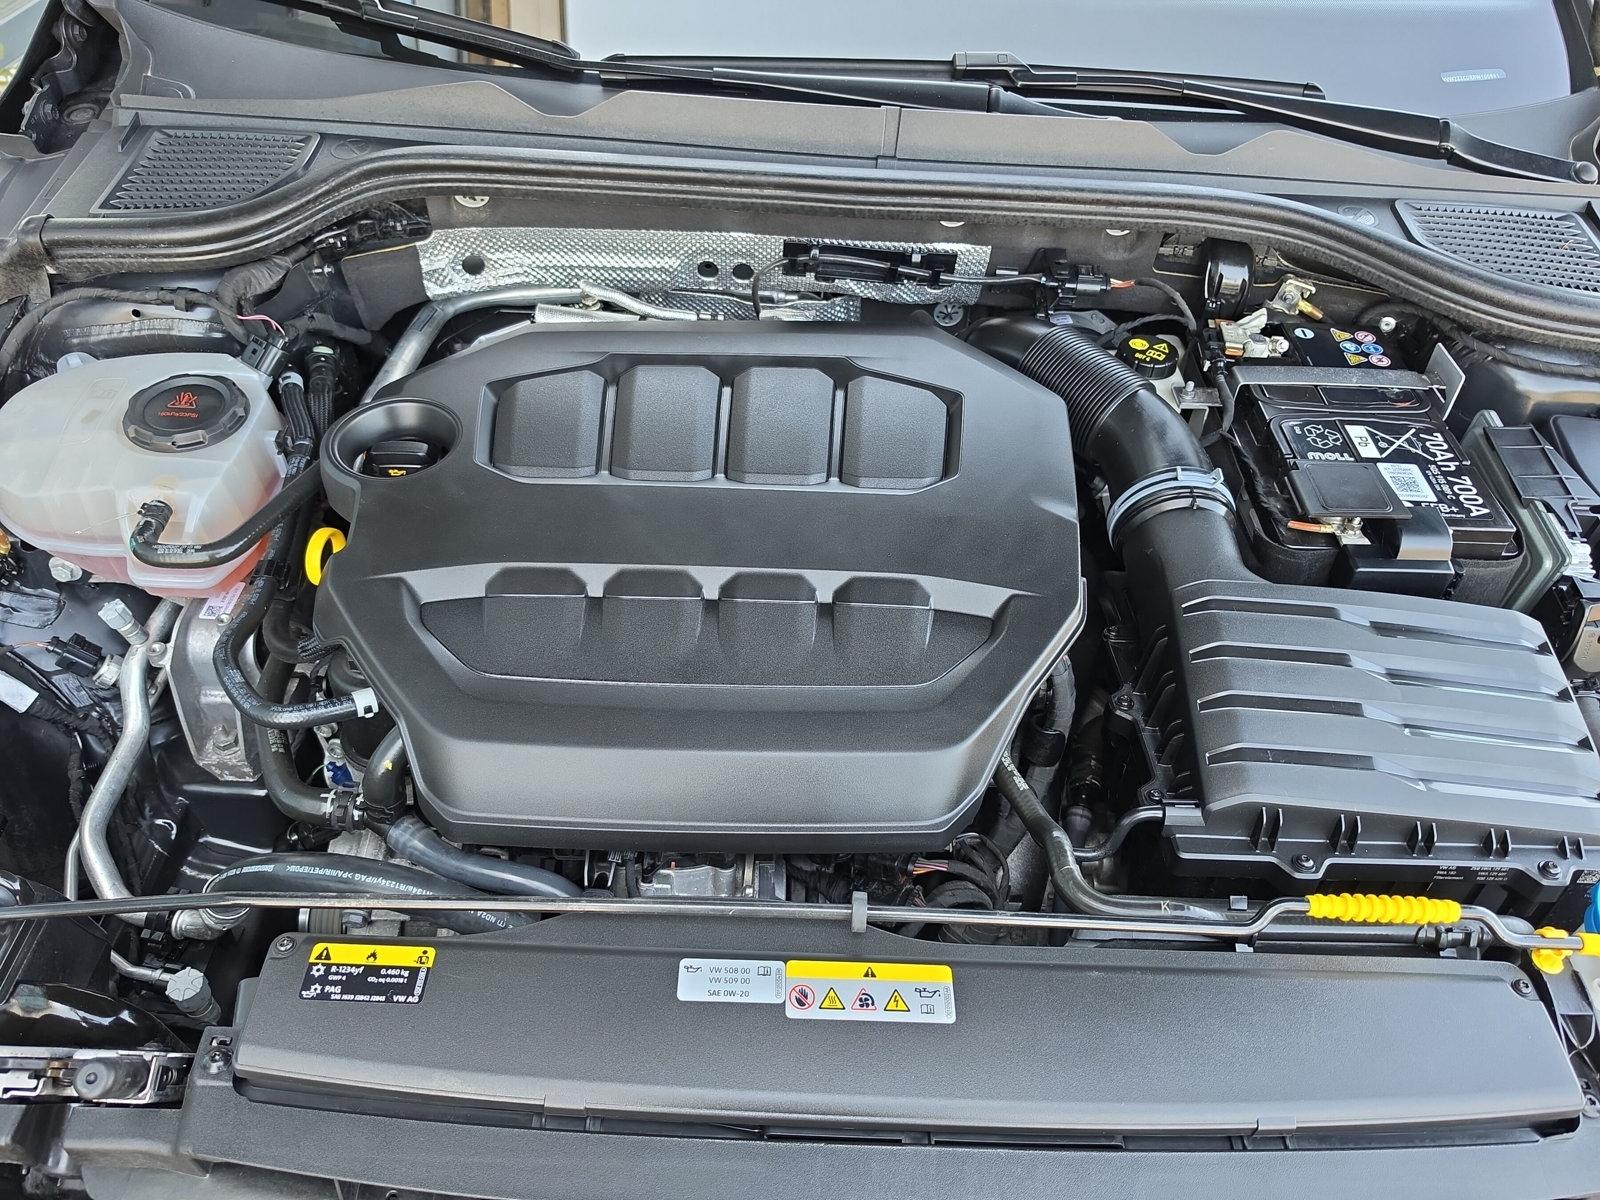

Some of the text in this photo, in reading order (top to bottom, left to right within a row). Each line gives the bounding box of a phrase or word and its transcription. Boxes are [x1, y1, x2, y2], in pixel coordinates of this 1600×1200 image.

[1355, 435, 1371, 448] Pb
[1419, 432, 1491, 517] 70Ah 700A
[330, 965, 364, 976] R-1234yf
[400, 969, 410, 977] kg
[709, 966, 722, 974] VW
[724, 967, 739, 975] 508
[724, 977, 739, 985] 509
[740, 977, 751, 985] 00
[324, 985, 342, 994] PAG
[707, 989, 750, 998] SAE 0W-20
[392, 994, 420, 1003] VW AG
